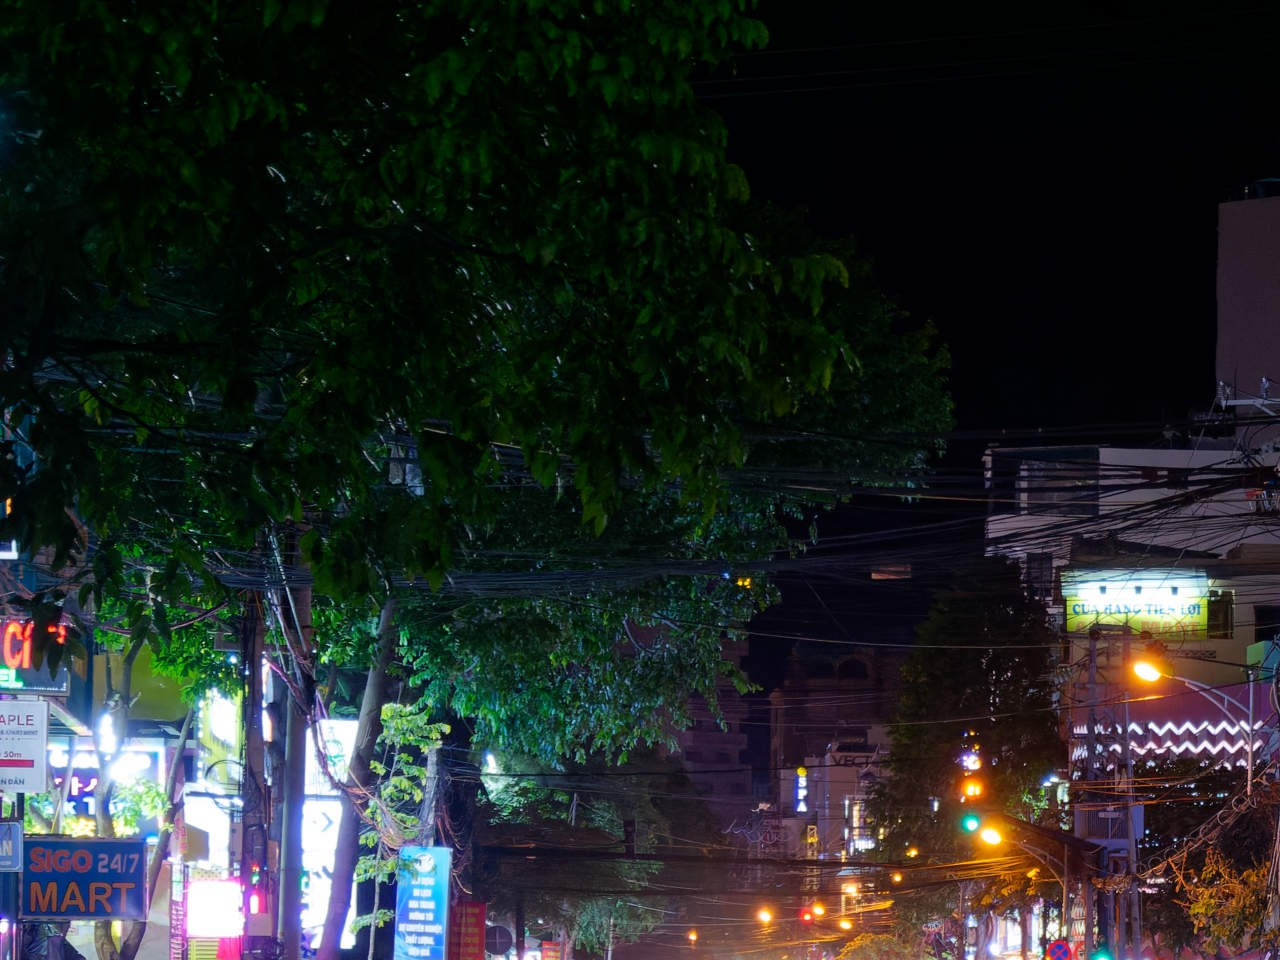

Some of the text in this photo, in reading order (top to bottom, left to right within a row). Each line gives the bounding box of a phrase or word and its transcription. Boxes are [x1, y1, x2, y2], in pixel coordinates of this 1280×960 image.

[30, 847, 140, 873] SIGO 24/7
[30, 881, 136, 913] MART
